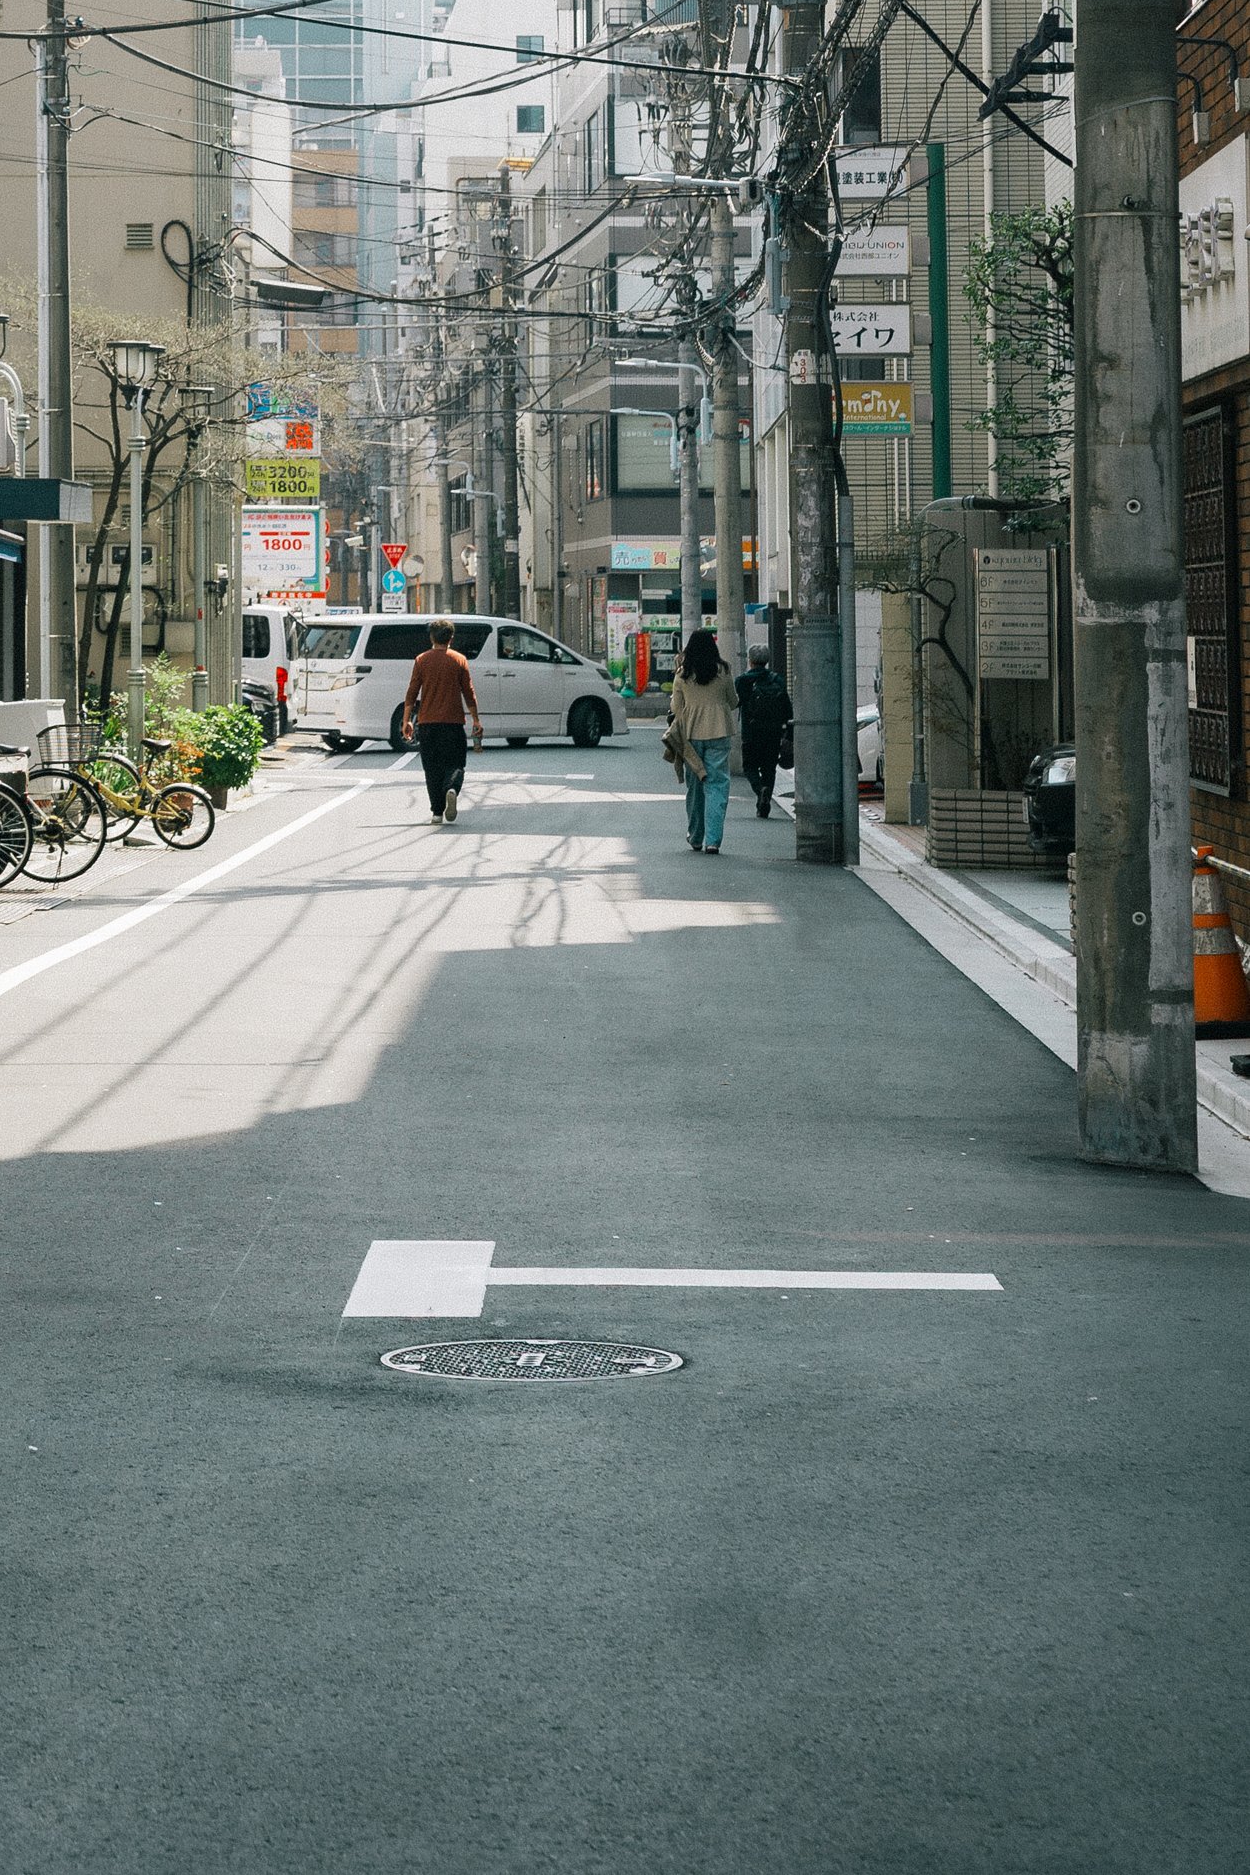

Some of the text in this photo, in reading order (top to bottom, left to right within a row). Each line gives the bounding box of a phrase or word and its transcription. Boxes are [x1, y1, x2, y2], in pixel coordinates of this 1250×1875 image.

[868, 241, 905, 249] UNION
[833, 311, 879, 322] 株式会社
